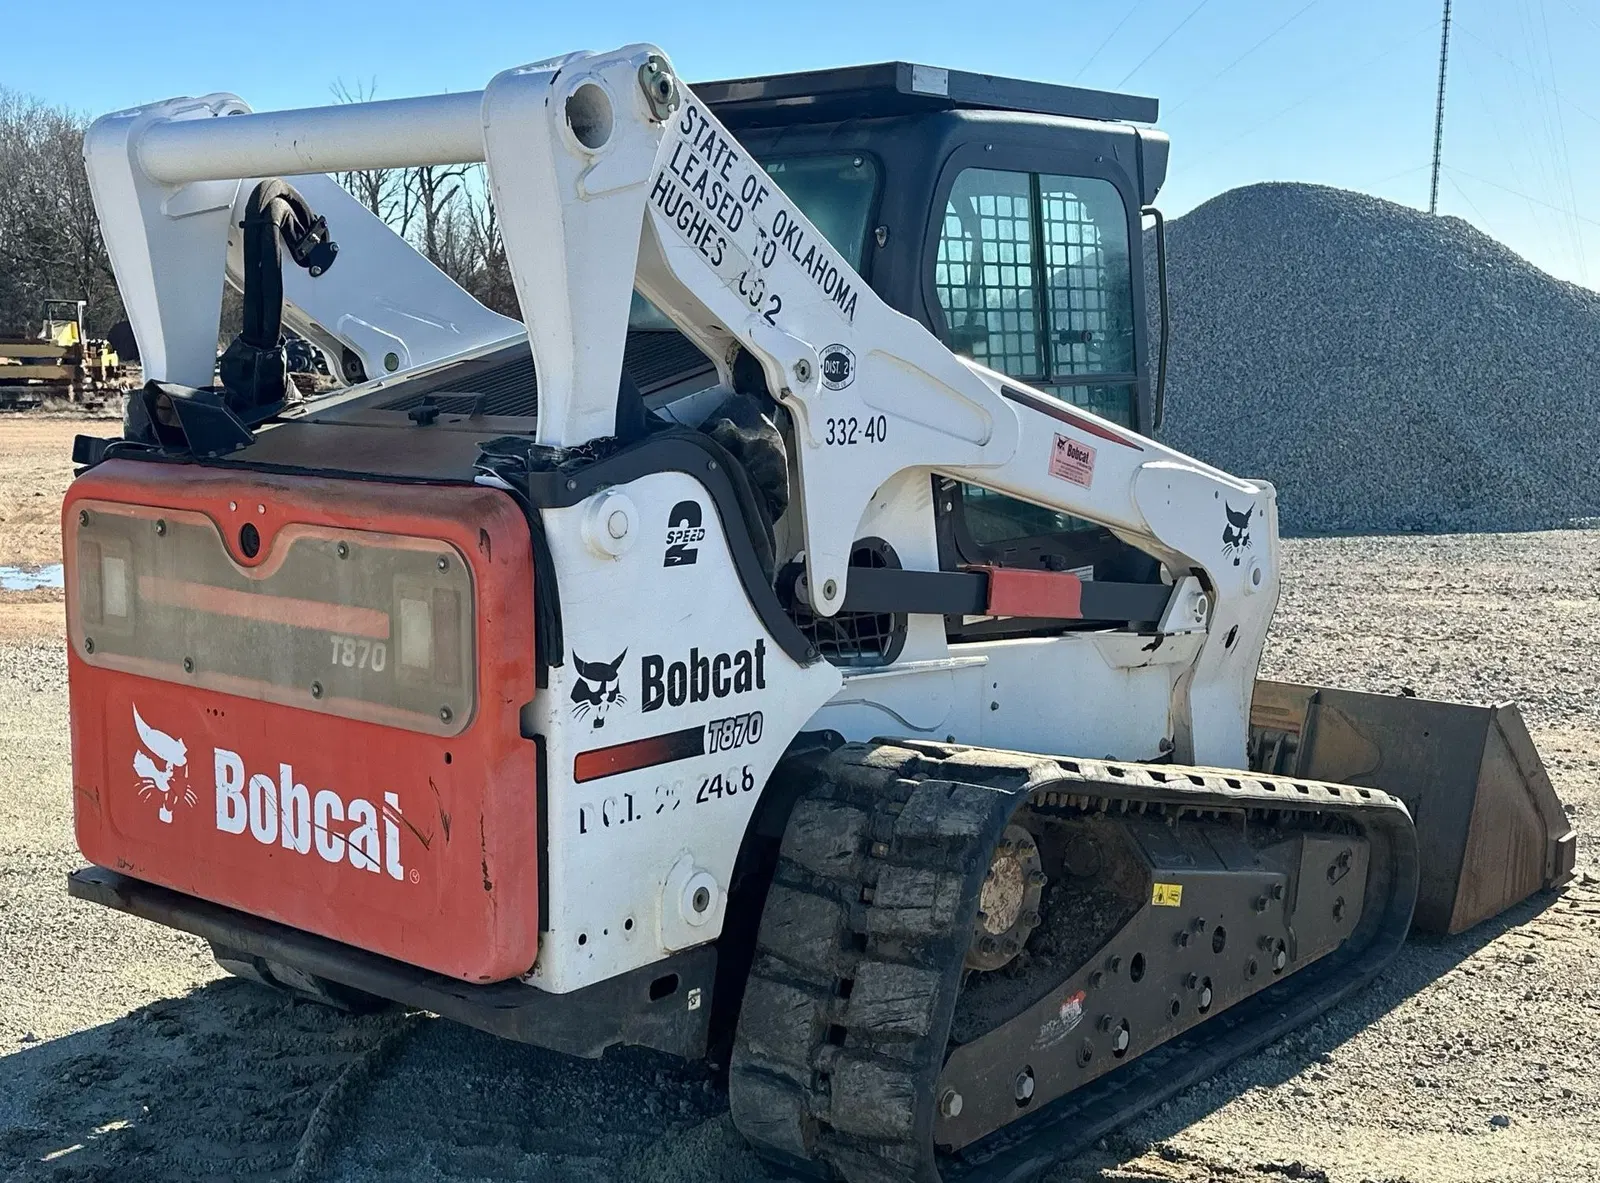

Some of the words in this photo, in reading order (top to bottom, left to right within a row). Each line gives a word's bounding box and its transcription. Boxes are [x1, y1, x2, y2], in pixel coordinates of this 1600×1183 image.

[669, 141, 744, 233] LEASED
[650, 172, 727, 266] HUGHES
[680, 105, 738, 182] STATE
[742, 174, 769, 211] OF
[773, 210, 858, 321] OKLAHOMA
[843, 361, 849, 375] 2
[825, 415, 887, 446] 332-40
[1067, 443, 1090, 464] Bobcat
[666, 529, 705, 544] SPEED
[330, 635, 387, 672] T870
[641, 638, 766, 713] Bobcat
[709, 711, 763, 754] T870
[213, 747, 404, 881] Bobcat
